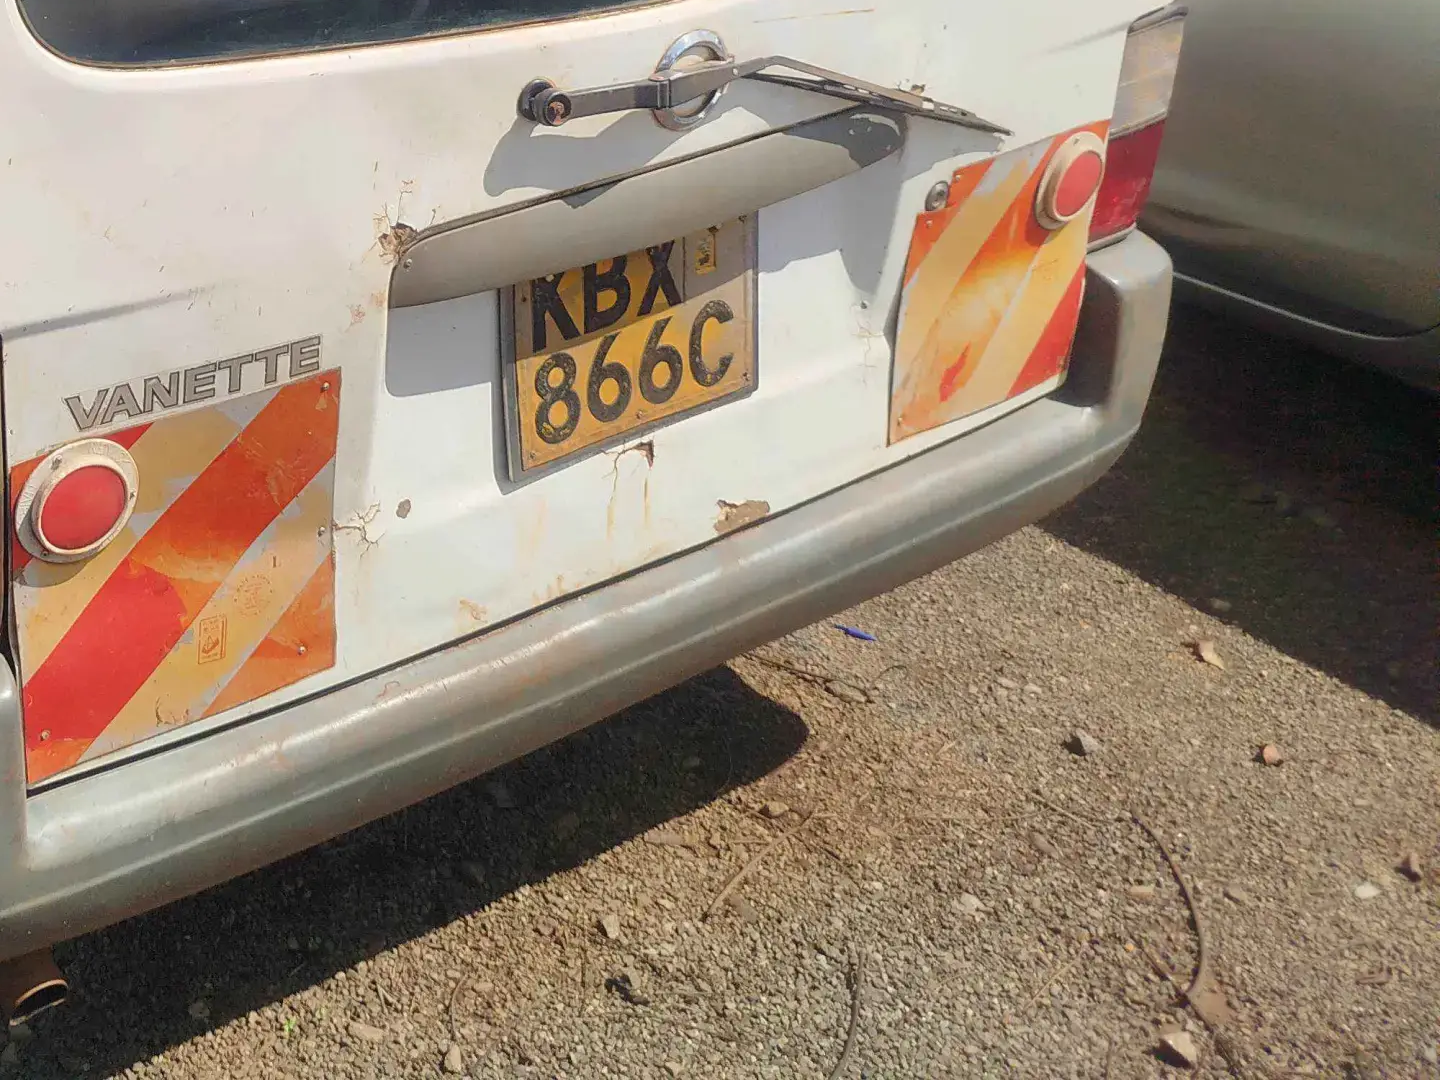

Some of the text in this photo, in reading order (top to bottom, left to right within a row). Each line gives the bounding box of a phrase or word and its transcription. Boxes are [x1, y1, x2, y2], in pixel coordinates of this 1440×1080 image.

[531, 239, 682, 353] KBX
[64, 335, 321, 431] VANETTE
[534, 299, 734, 444] 866C
